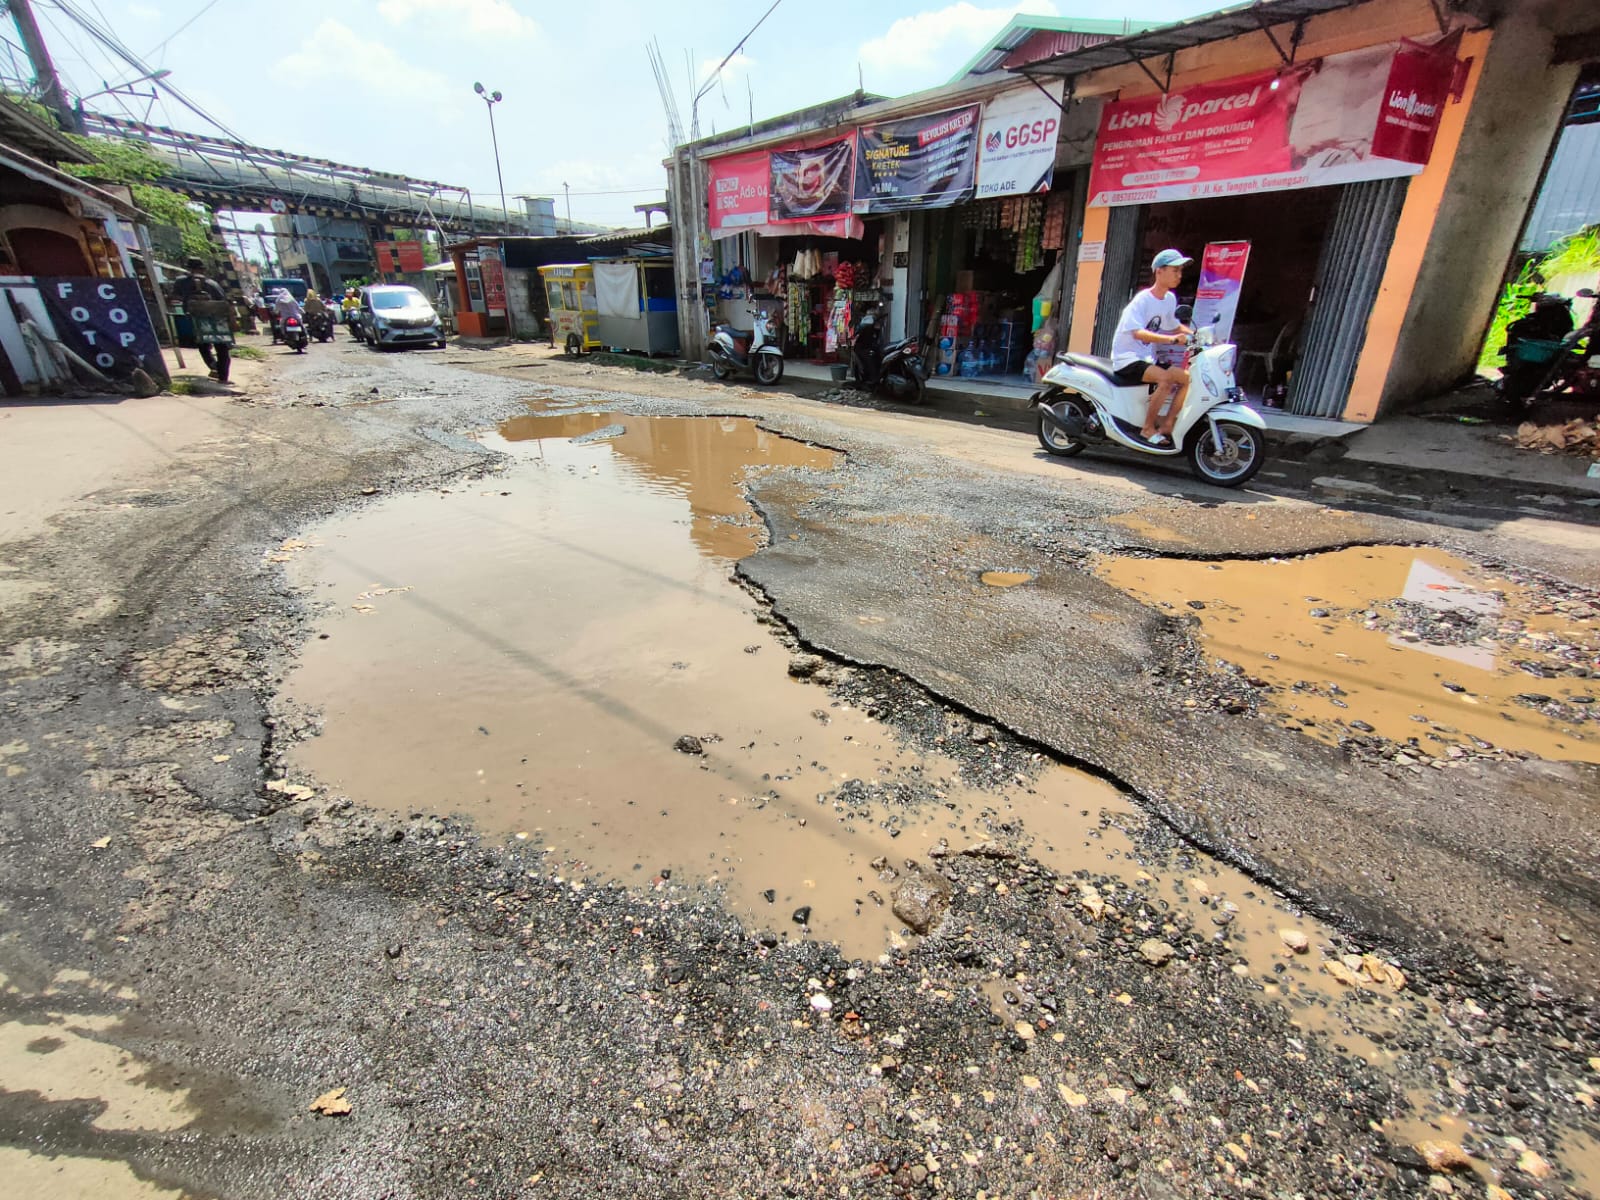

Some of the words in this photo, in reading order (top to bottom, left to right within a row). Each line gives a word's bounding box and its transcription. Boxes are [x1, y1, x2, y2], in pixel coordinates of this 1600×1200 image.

[1108, 110, 1153, 131] Lion
[1182, 86, 1261, 122] parcel
[1389, 90, 1408, 110] Lion
[1411, 102, 1437, 118] parcel
[1005, 118, 1057, 149] GGSP
[1102, 135, 1153, 152] PENGIRIMAN
[1154, 131, 1184, 145] PAKET
[1185, 128, 1204, 140] DAN
[1206, 119, 1255, 136] DOKUMEN
[865, 144, 910, 160] SIGNATURE
[871, 160, 901, 170] KRETEK
[739, 186, 755, 199] Ade
[1000, 180, 1017, 191] ADE
[722, 194, 740, 209] SRC
[97, 284, 146, 362] COP
